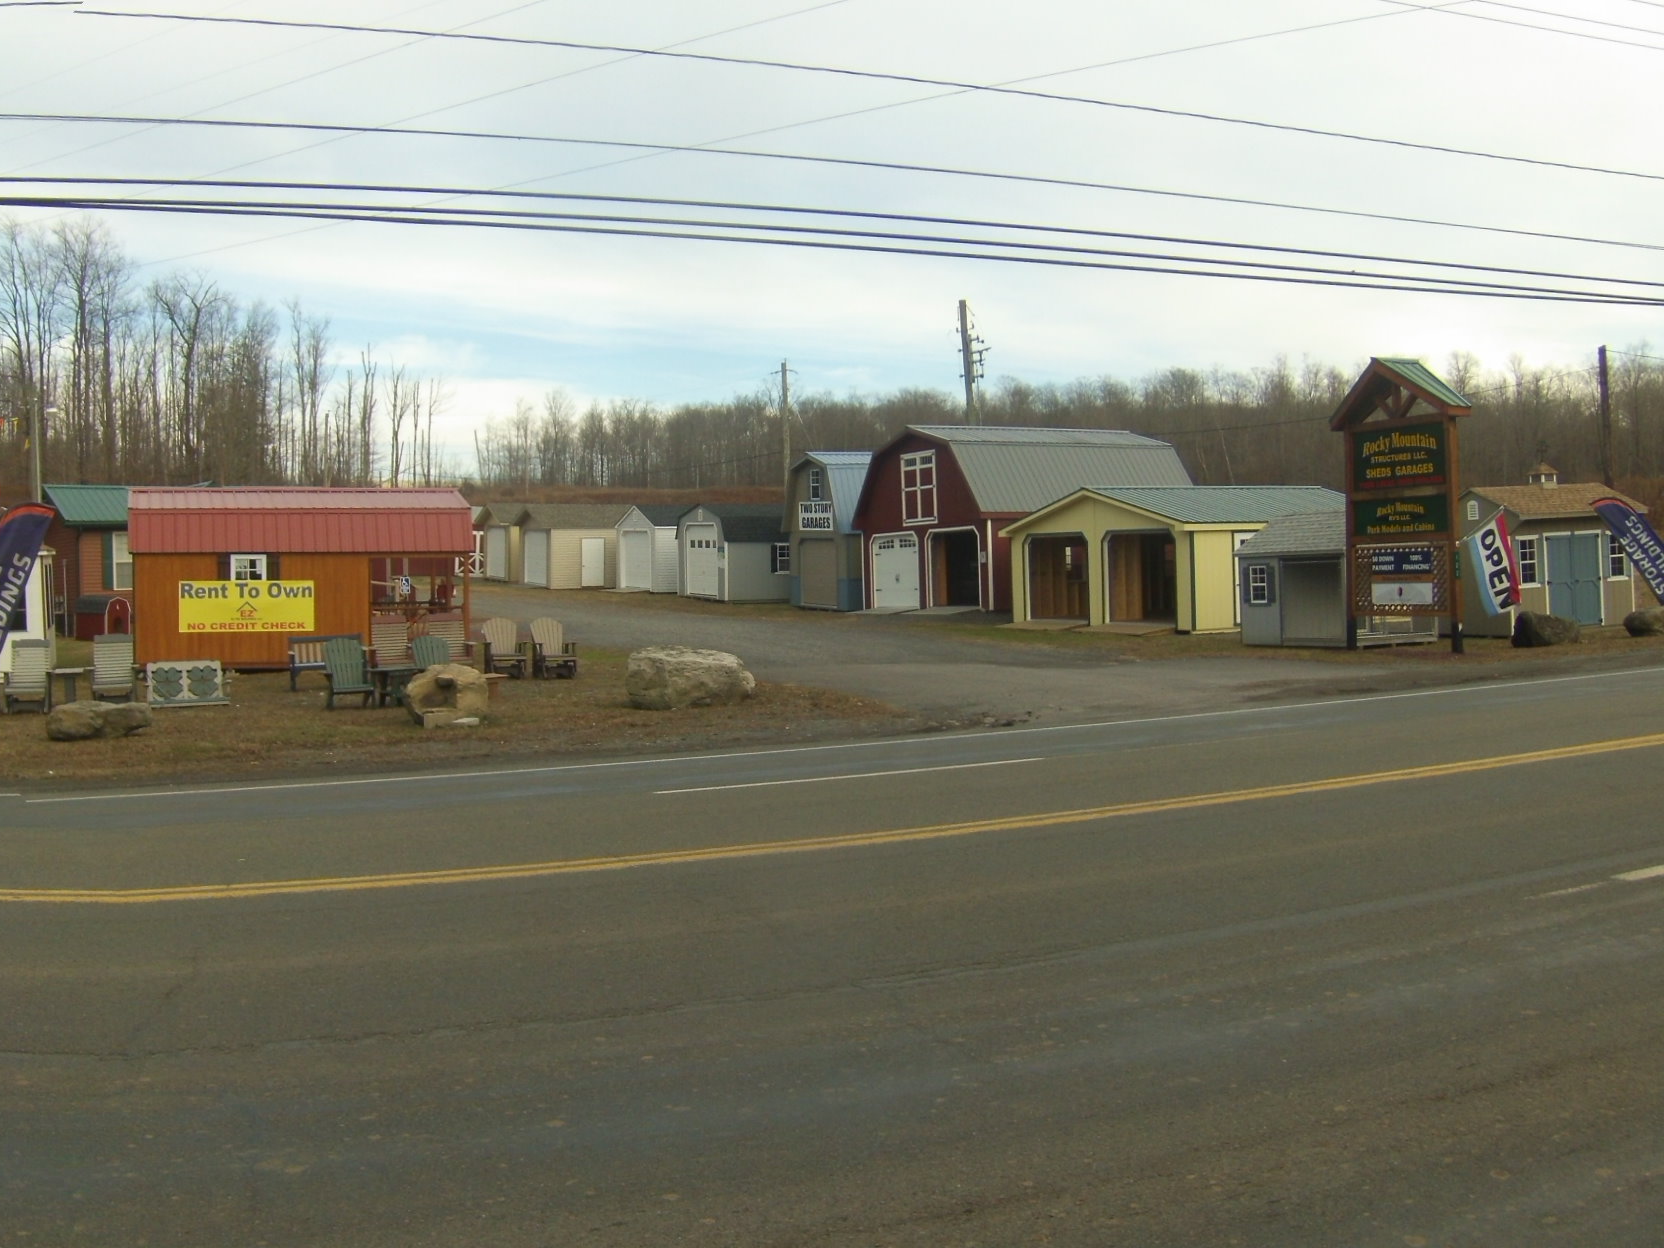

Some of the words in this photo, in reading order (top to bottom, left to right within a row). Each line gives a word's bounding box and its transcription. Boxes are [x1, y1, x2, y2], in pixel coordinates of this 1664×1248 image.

[1362, 435, 1391, 458] Rocky
[1391, 432, 1437, 450] Mountain
[1370, 452, 1411, 464] STRUCTURES
[1366, 467, 1392, 478] SHEDS
[1395, 463, 1434, 476] GARAGES
[800, 504, 813, 513] TWO
[814, 504, 832, 513] STORY
[1376, 504, 1395, 517] Rocky
[1395, 502, 1425, 514] Mountain
[802, 517, 831, 528] GARAGES
[1367, 526, 1380, 534] Park
[1402, 524, 1414, 532] and
[1414, 523, 1435, 531] Cabins
[1481, 528, 1515, 609] OPEN
[1620, 533, 1664, 595] STORAGE
[180, 583, 229, 599] Rent
[234, 582, 260, 598] To
[267, 582, 313, 598] Own
[240, 609, 255, 617] EZ
[187, 622, 206, 630] NO
[210, 622, 258, 630] CREDIT
[261, 621, 306, 630] CHECK
